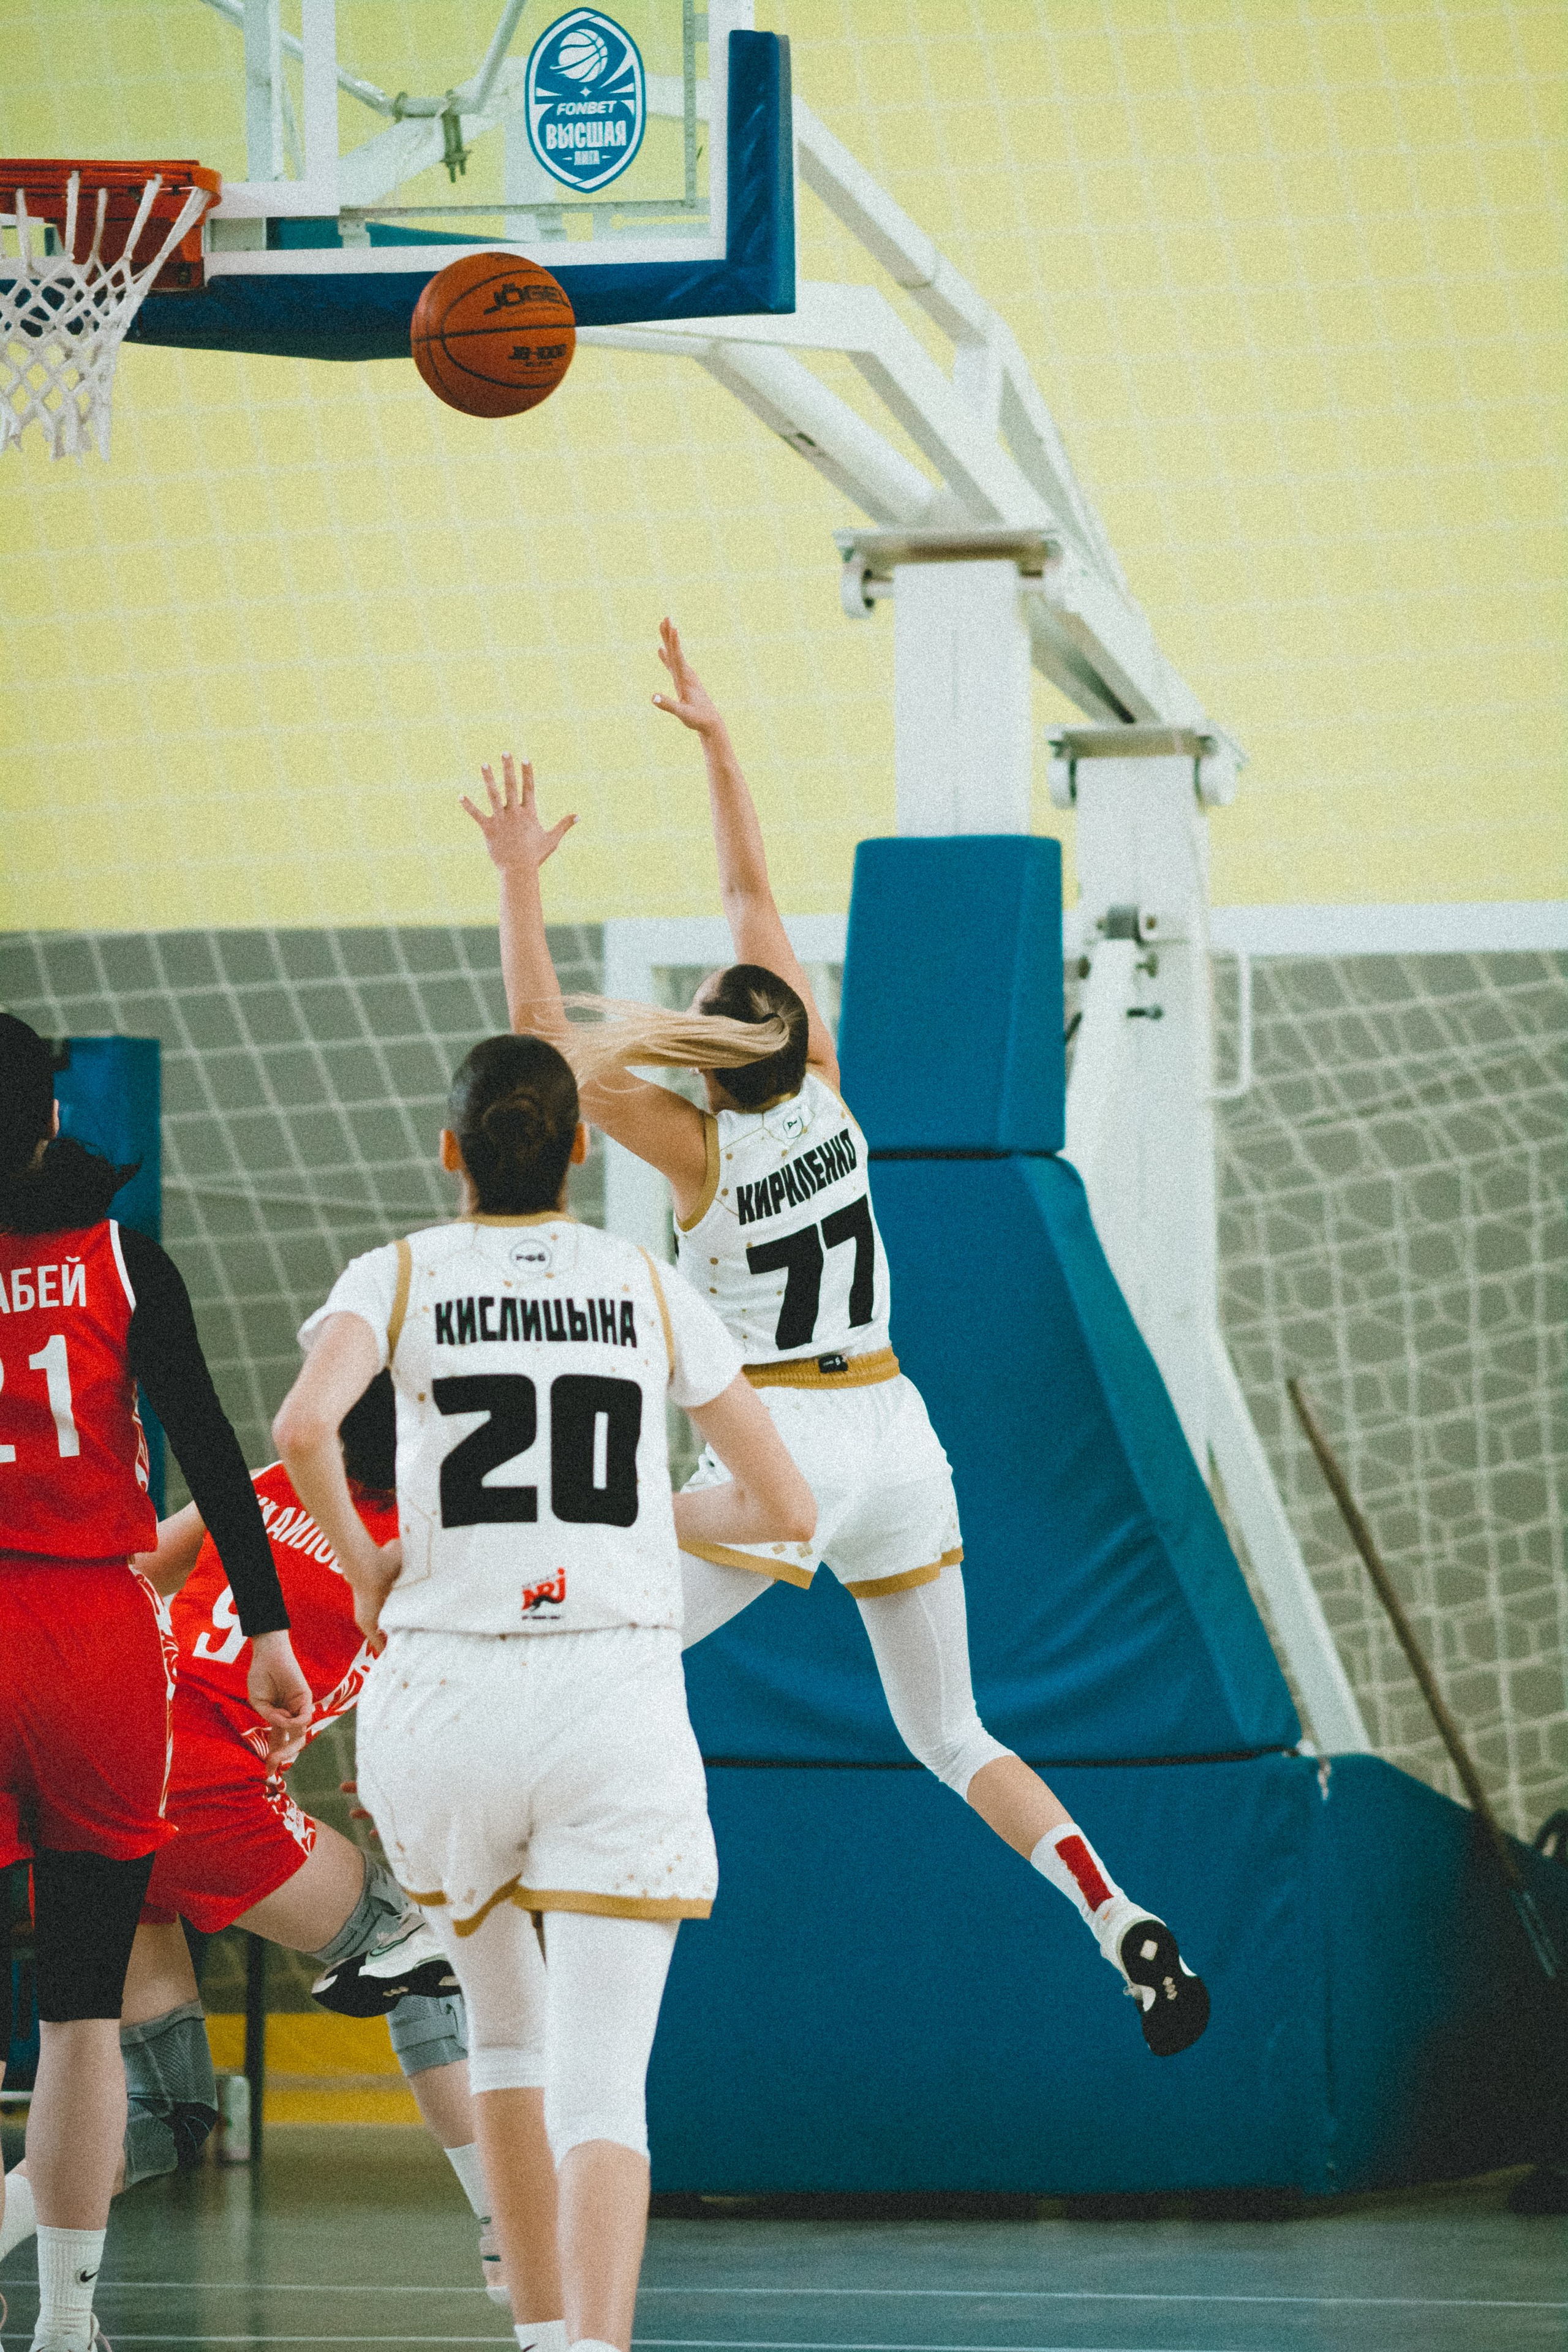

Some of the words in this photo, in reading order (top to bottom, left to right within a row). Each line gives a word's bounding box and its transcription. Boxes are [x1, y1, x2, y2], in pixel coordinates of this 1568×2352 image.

[545, 120, 627, 149] ВЫСШАЯ
[556, 100, 617, 116] FONBET
[736, 1128, 857, 1225] КИРИЛЕНКО
[746, 1193, 875, 1351] 77
[435, 1296, 637, 1348] КИСЛИЦЫНА
[432, 1373, 643, 1528] 20
